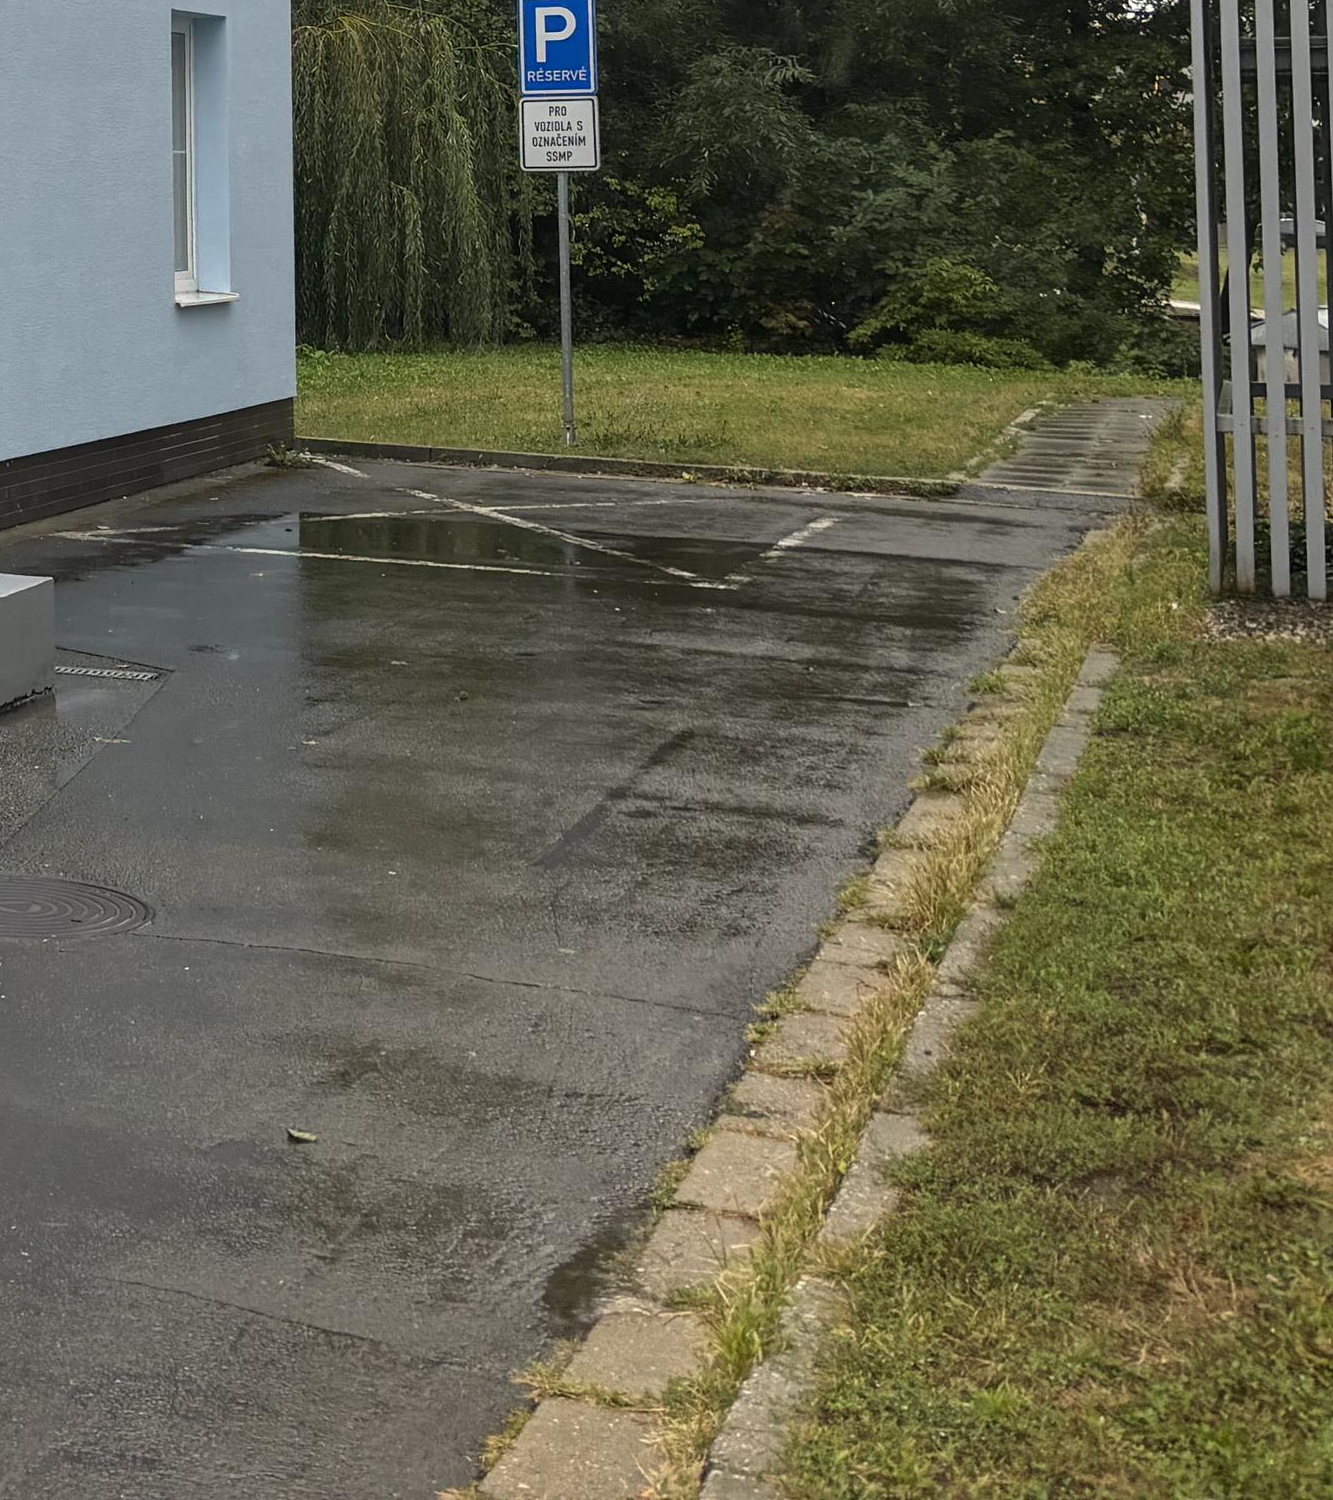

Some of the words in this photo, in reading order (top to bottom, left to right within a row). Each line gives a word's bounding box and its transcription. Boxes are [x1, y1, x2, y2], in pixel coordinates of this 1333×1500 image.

[535, 6, 577, 63] P
[527, 66, 587, 82] RÉSERVÉ
[548, 106, 567, 117] PRO
[534, 121, 573, 132] VOZIDLA
[576, 120, 583, 131] S
[532, 133, 586, 148] OZNAČENÍM
[546, 151, 573, 162] SSMP
